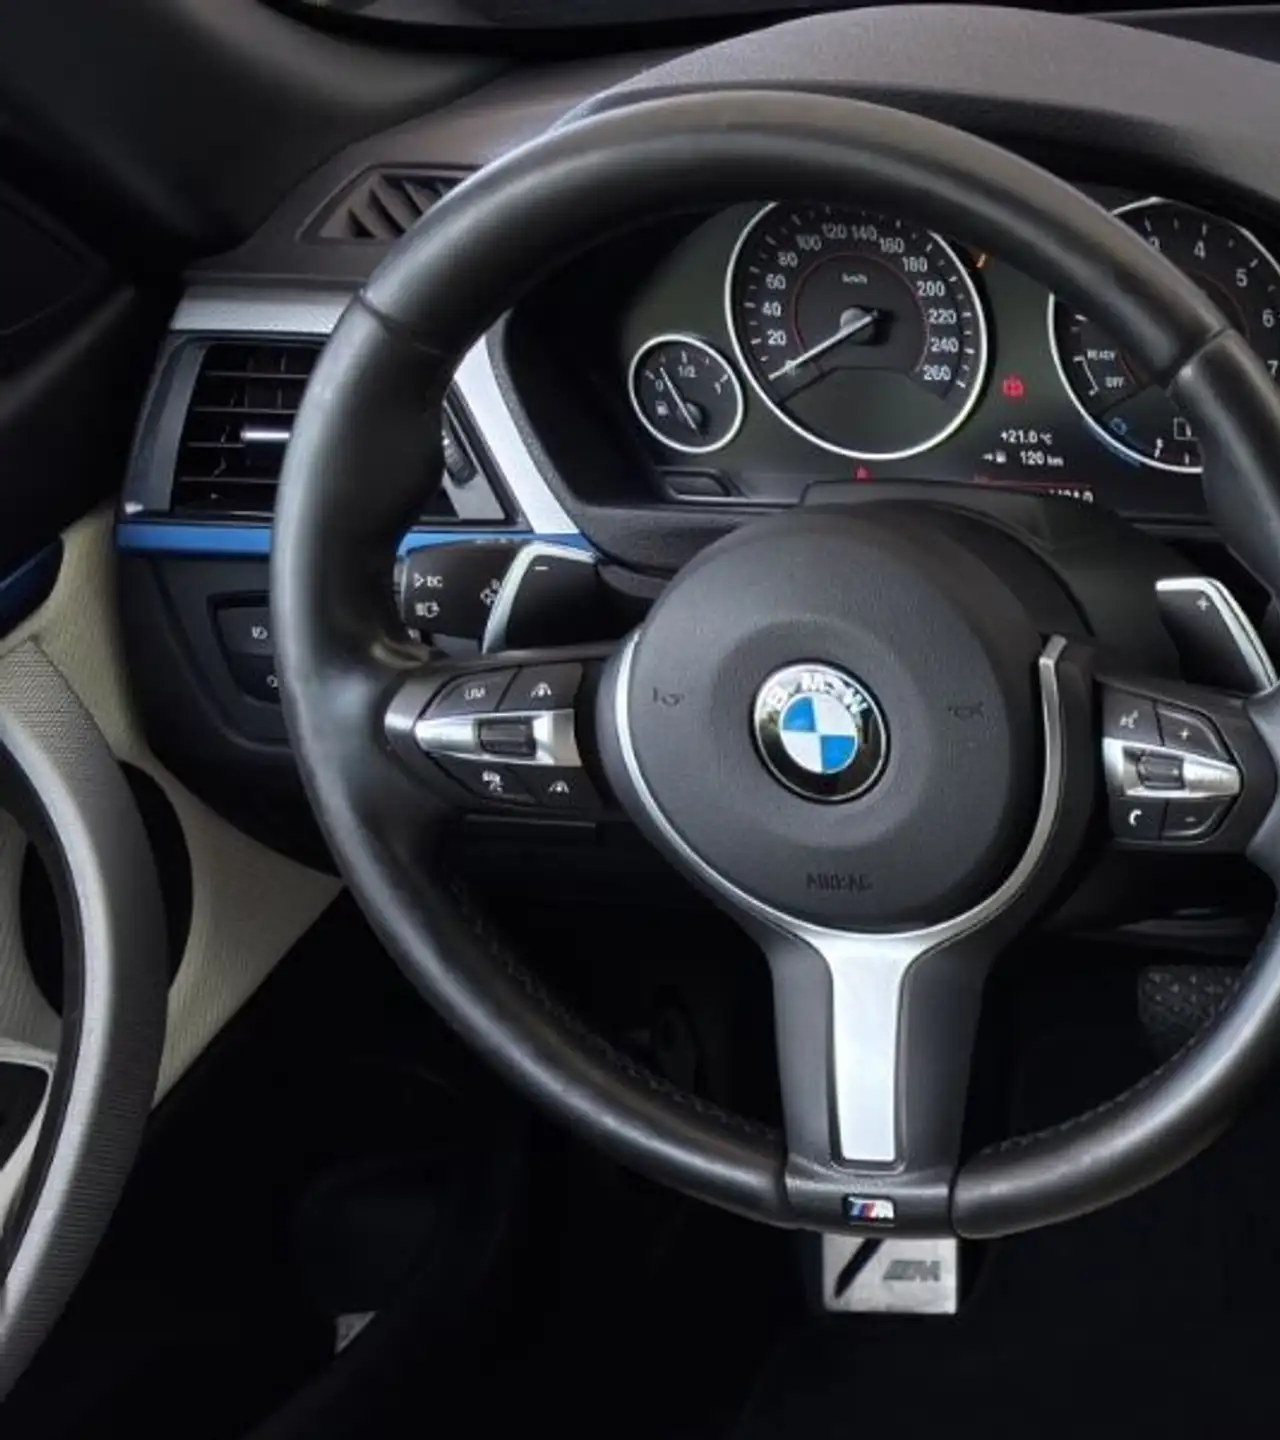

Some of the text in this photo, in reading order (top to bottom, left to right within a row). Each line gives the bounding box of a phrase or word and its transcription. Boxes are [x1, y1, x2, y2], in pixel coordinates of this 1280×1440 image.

[821, 222, 847, 240] 120
[850, 224, 878, 242] 140
[1193, 241, 1206, 260] 4
[765, 273, 787, 290] 60
[1235, 268, 1249, 288] 5
[916, 280, 946, 298] 200
[761, 301, 782, 318] 40
[927, 309, 957, 325] 220
[1261, 308, 1275, 328] 6
[766, 330, 787, 346] 20
[930, 337, 960, 353] 240
[922, 365, 952, 381] 260
[1267, 359, 1279, 376] 7
[1020, 450, 1045, 466] 120
[765, 671, 868, 714] BMW
